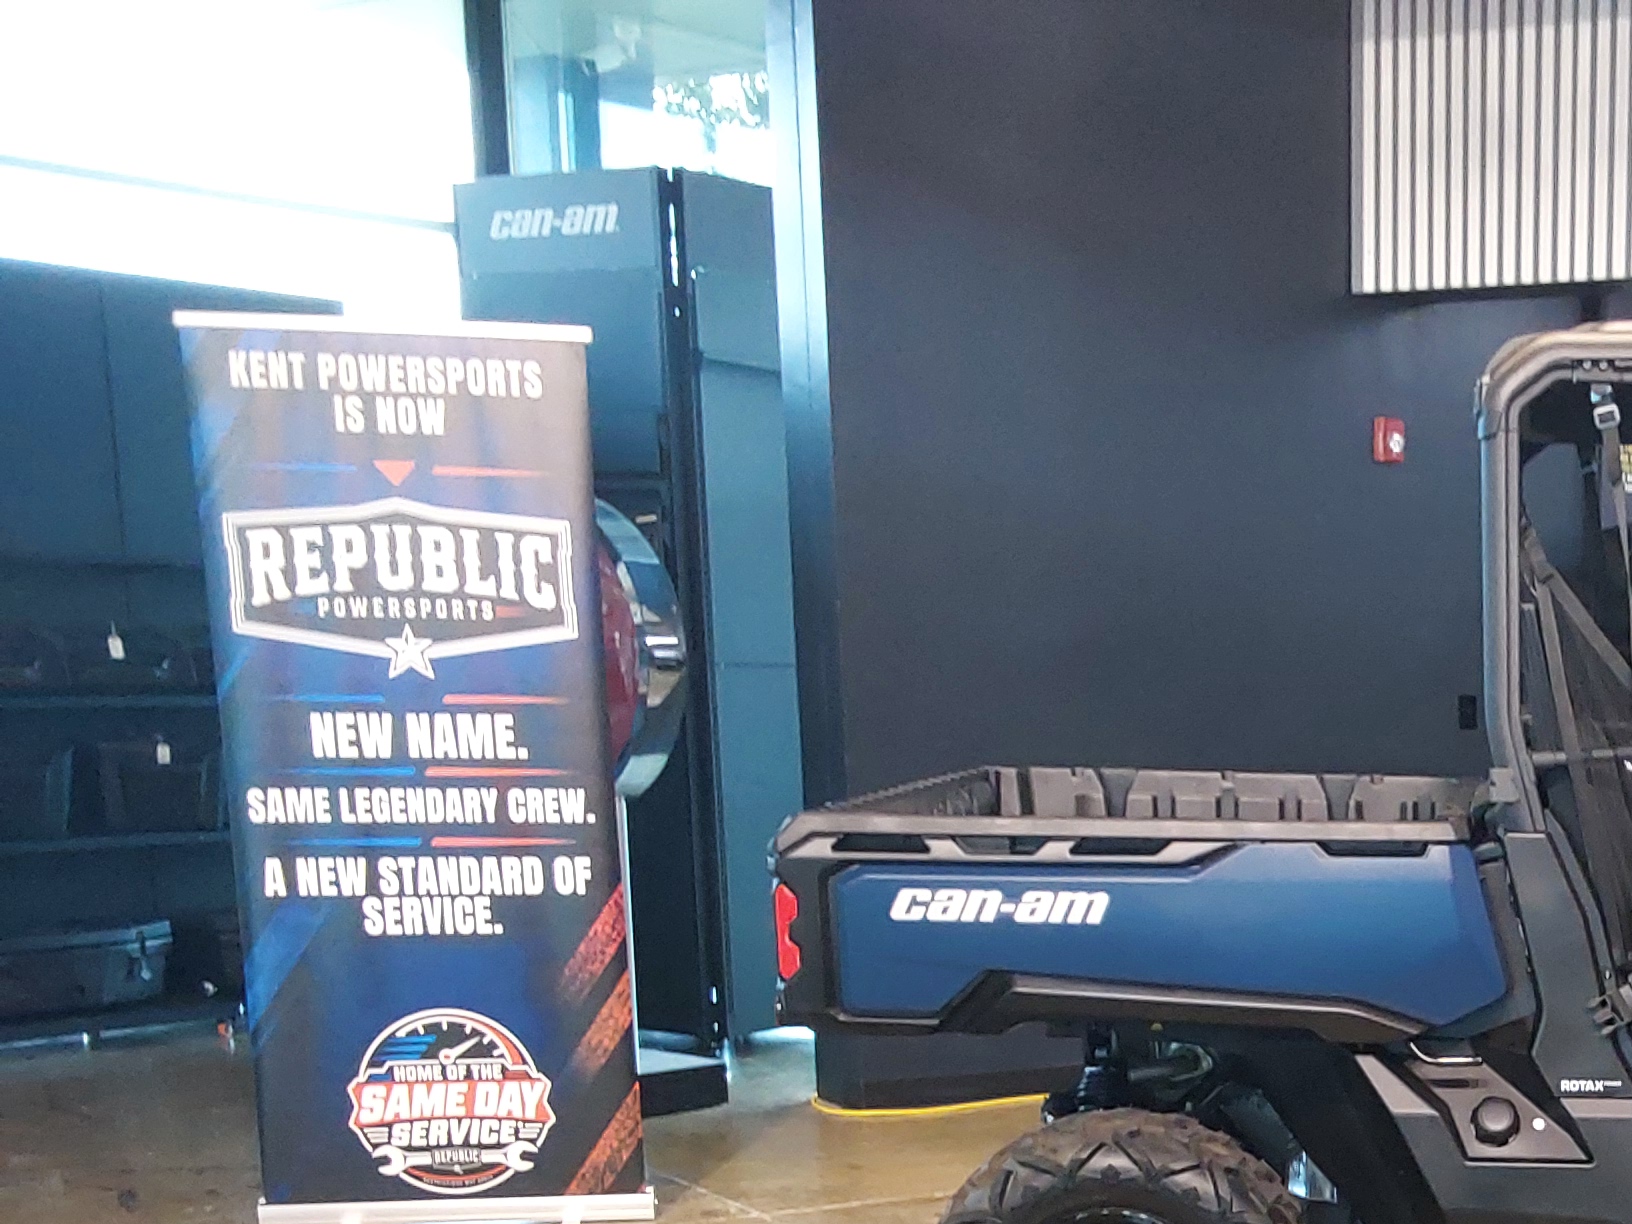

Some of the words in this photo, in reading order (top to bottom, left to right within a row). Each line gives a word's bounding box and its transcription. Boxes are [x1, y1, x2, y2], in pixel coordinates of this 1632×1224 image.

[489, 201, 619, 240] can-am
[228, 350, 305, 390] KENT
[317, 352, 543, 399] POWERSPORTS
[333, 394, 365, 433] IS
[375, 395, 446, 435] NOW
[245, 524, 556, 611] REPUBLIC
[317, 596, 494, 621] POWERSPORTS
[309, 711, 393, 759] NEW
[405, 711, 529, 760] NAME.
[246, 786, 332, 824] SAME
[338, 786, 498, 824] LEGENDARY
[507, 786, 596, 824] CREW.
[263, 855, 287, 897] A
[296, 855, 366, 897] NEW
[378, 855, 544, 897] STANDARD
[553, 855, 592, 896] OF
[362, 896, 504, 936] SERVICE.
[890, 888, 1109, 924] can-am
[393, 1064, 443, 1081] HOME
[448, 1065, 466, 1080] OF
[470, 1064, 502, 1080] THE
[1560, 1079, 1604, 1092] ROTAX
[358, 1082, 468, 1125] SAME
[474, 1081, 544, 1118] DAY
[391, 1118, 516, 1146] SERVICE
[433, 1148, 480, 1164] REPUBLIC
